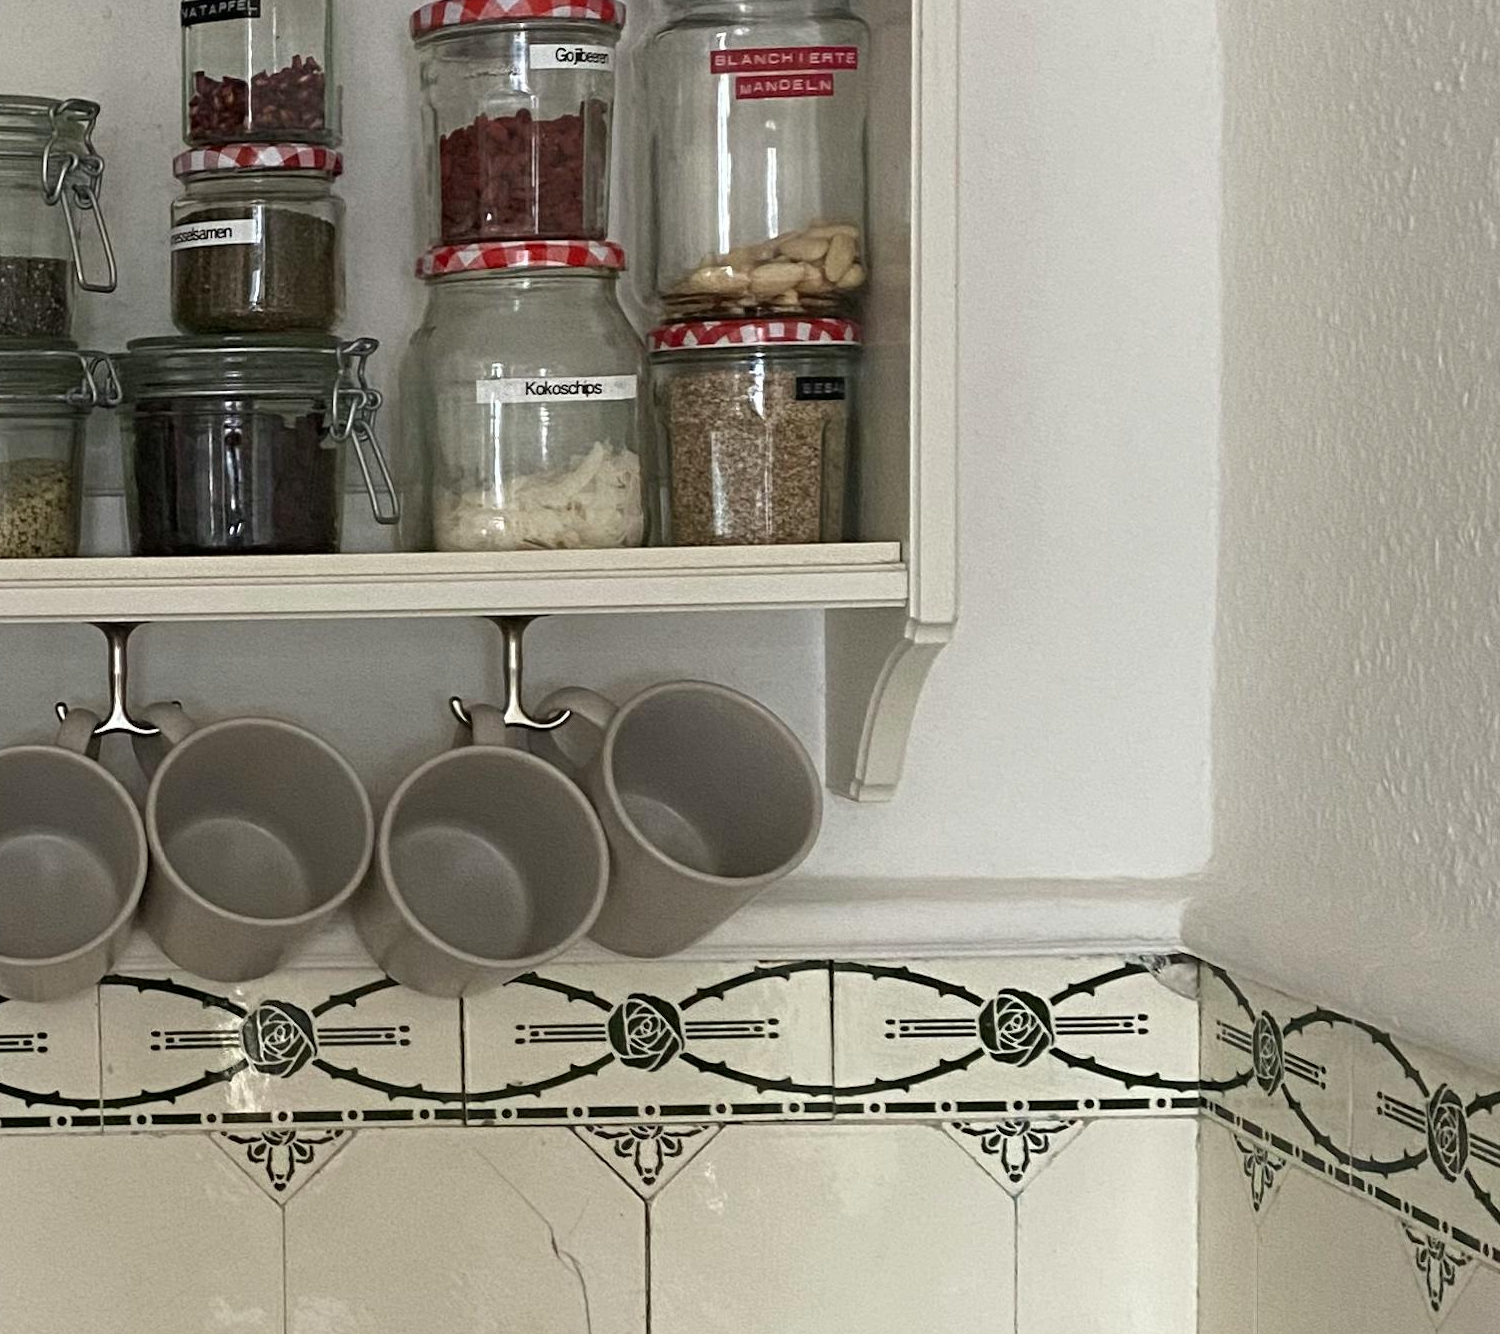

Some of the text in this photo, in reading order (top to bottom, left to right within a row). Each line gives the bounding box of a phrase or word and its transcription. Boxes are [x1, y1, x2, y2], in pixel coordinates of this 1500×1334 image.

[714, 52, 857, 67] BLANCHIERTE
[739, 78, 833, 95] MANDELN
[525, 380, 604, 397] Kokoschips
